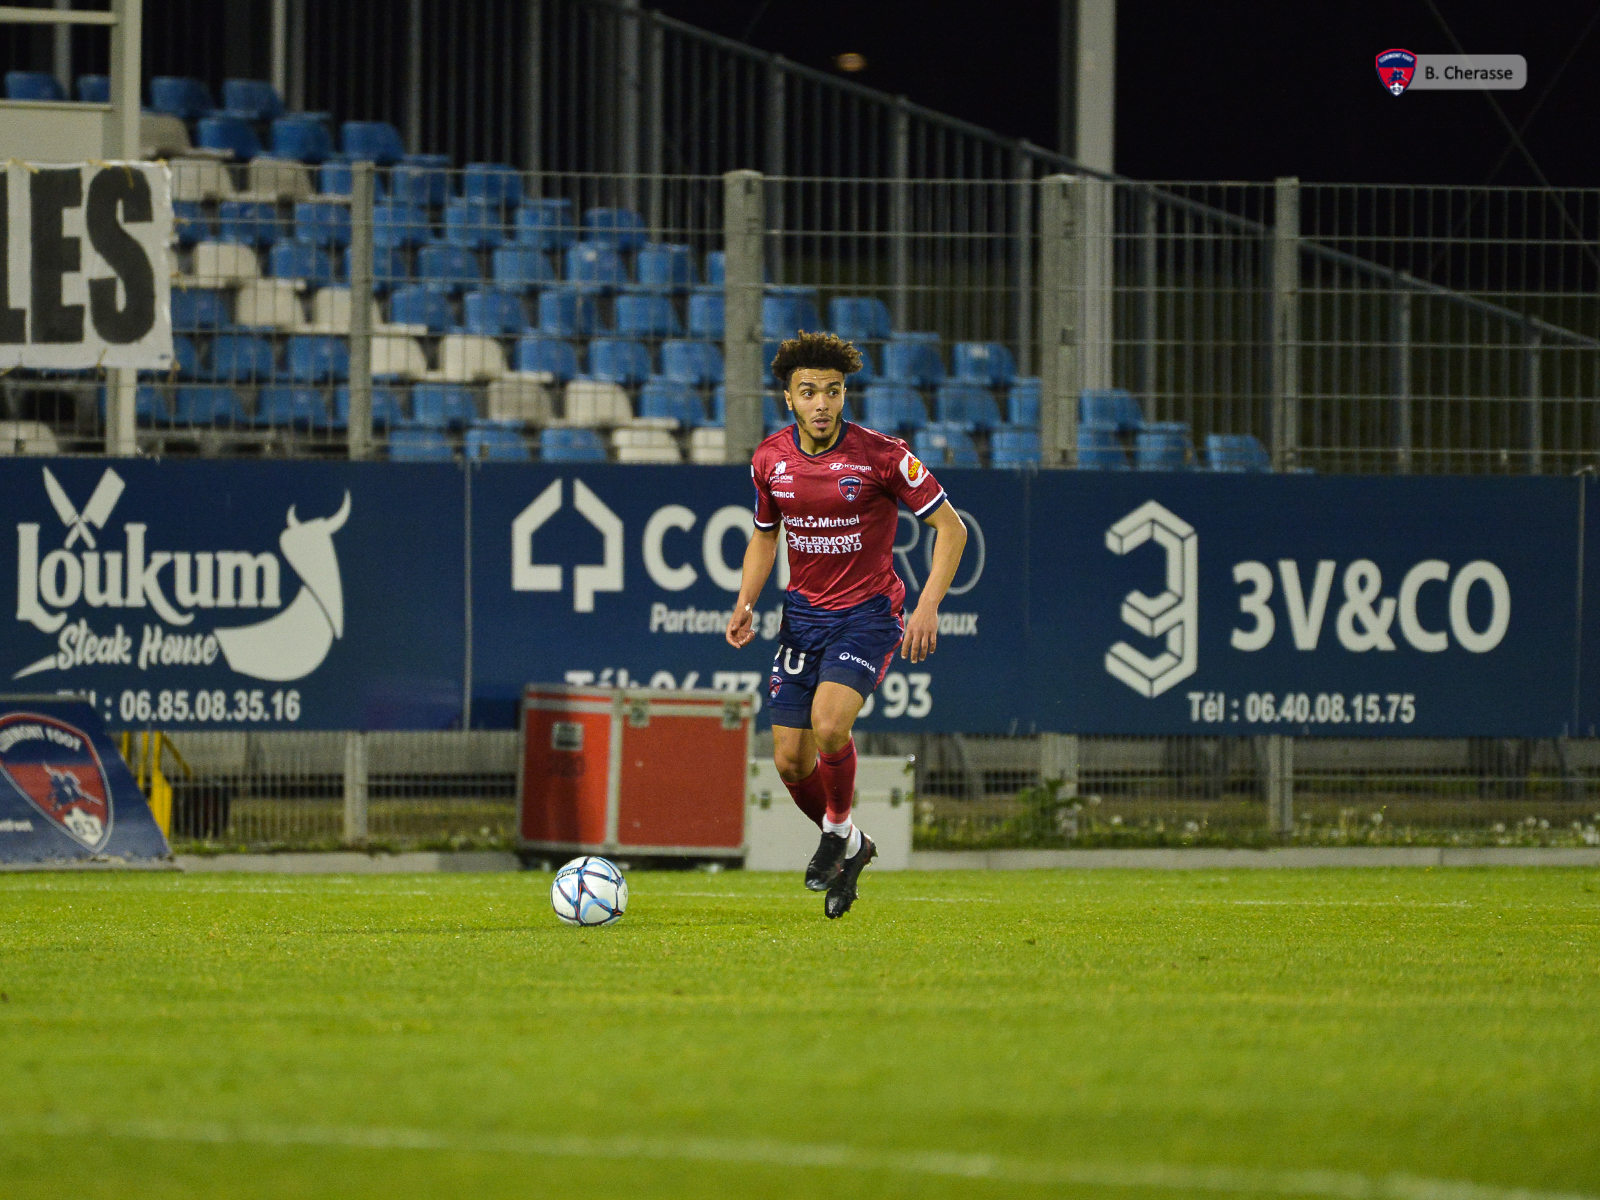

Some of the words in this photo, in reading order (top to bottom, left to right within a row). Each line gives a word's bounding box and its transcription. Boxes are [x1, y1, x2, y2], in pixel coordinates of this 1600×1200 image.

[818, 514, 860, 528] Mutuel
[798, 533, 861, 547] CLERMONT
[800, 542, 863, 554] FERRAND
[16, 522, 281, 634] Loukum
[1230, 557, 1512, 655] 3V&CO
[57, 618, 131, 670] Steak
[139, 624, 218, 671] House
[850, 654, 876, 674] VEOLIA
[119, 689, 300, 722] 06.85.08.35.16
[1187, 691, 1225, 723] Tél
[1245, 692, 1416, 724] 06.40.08.15.75
